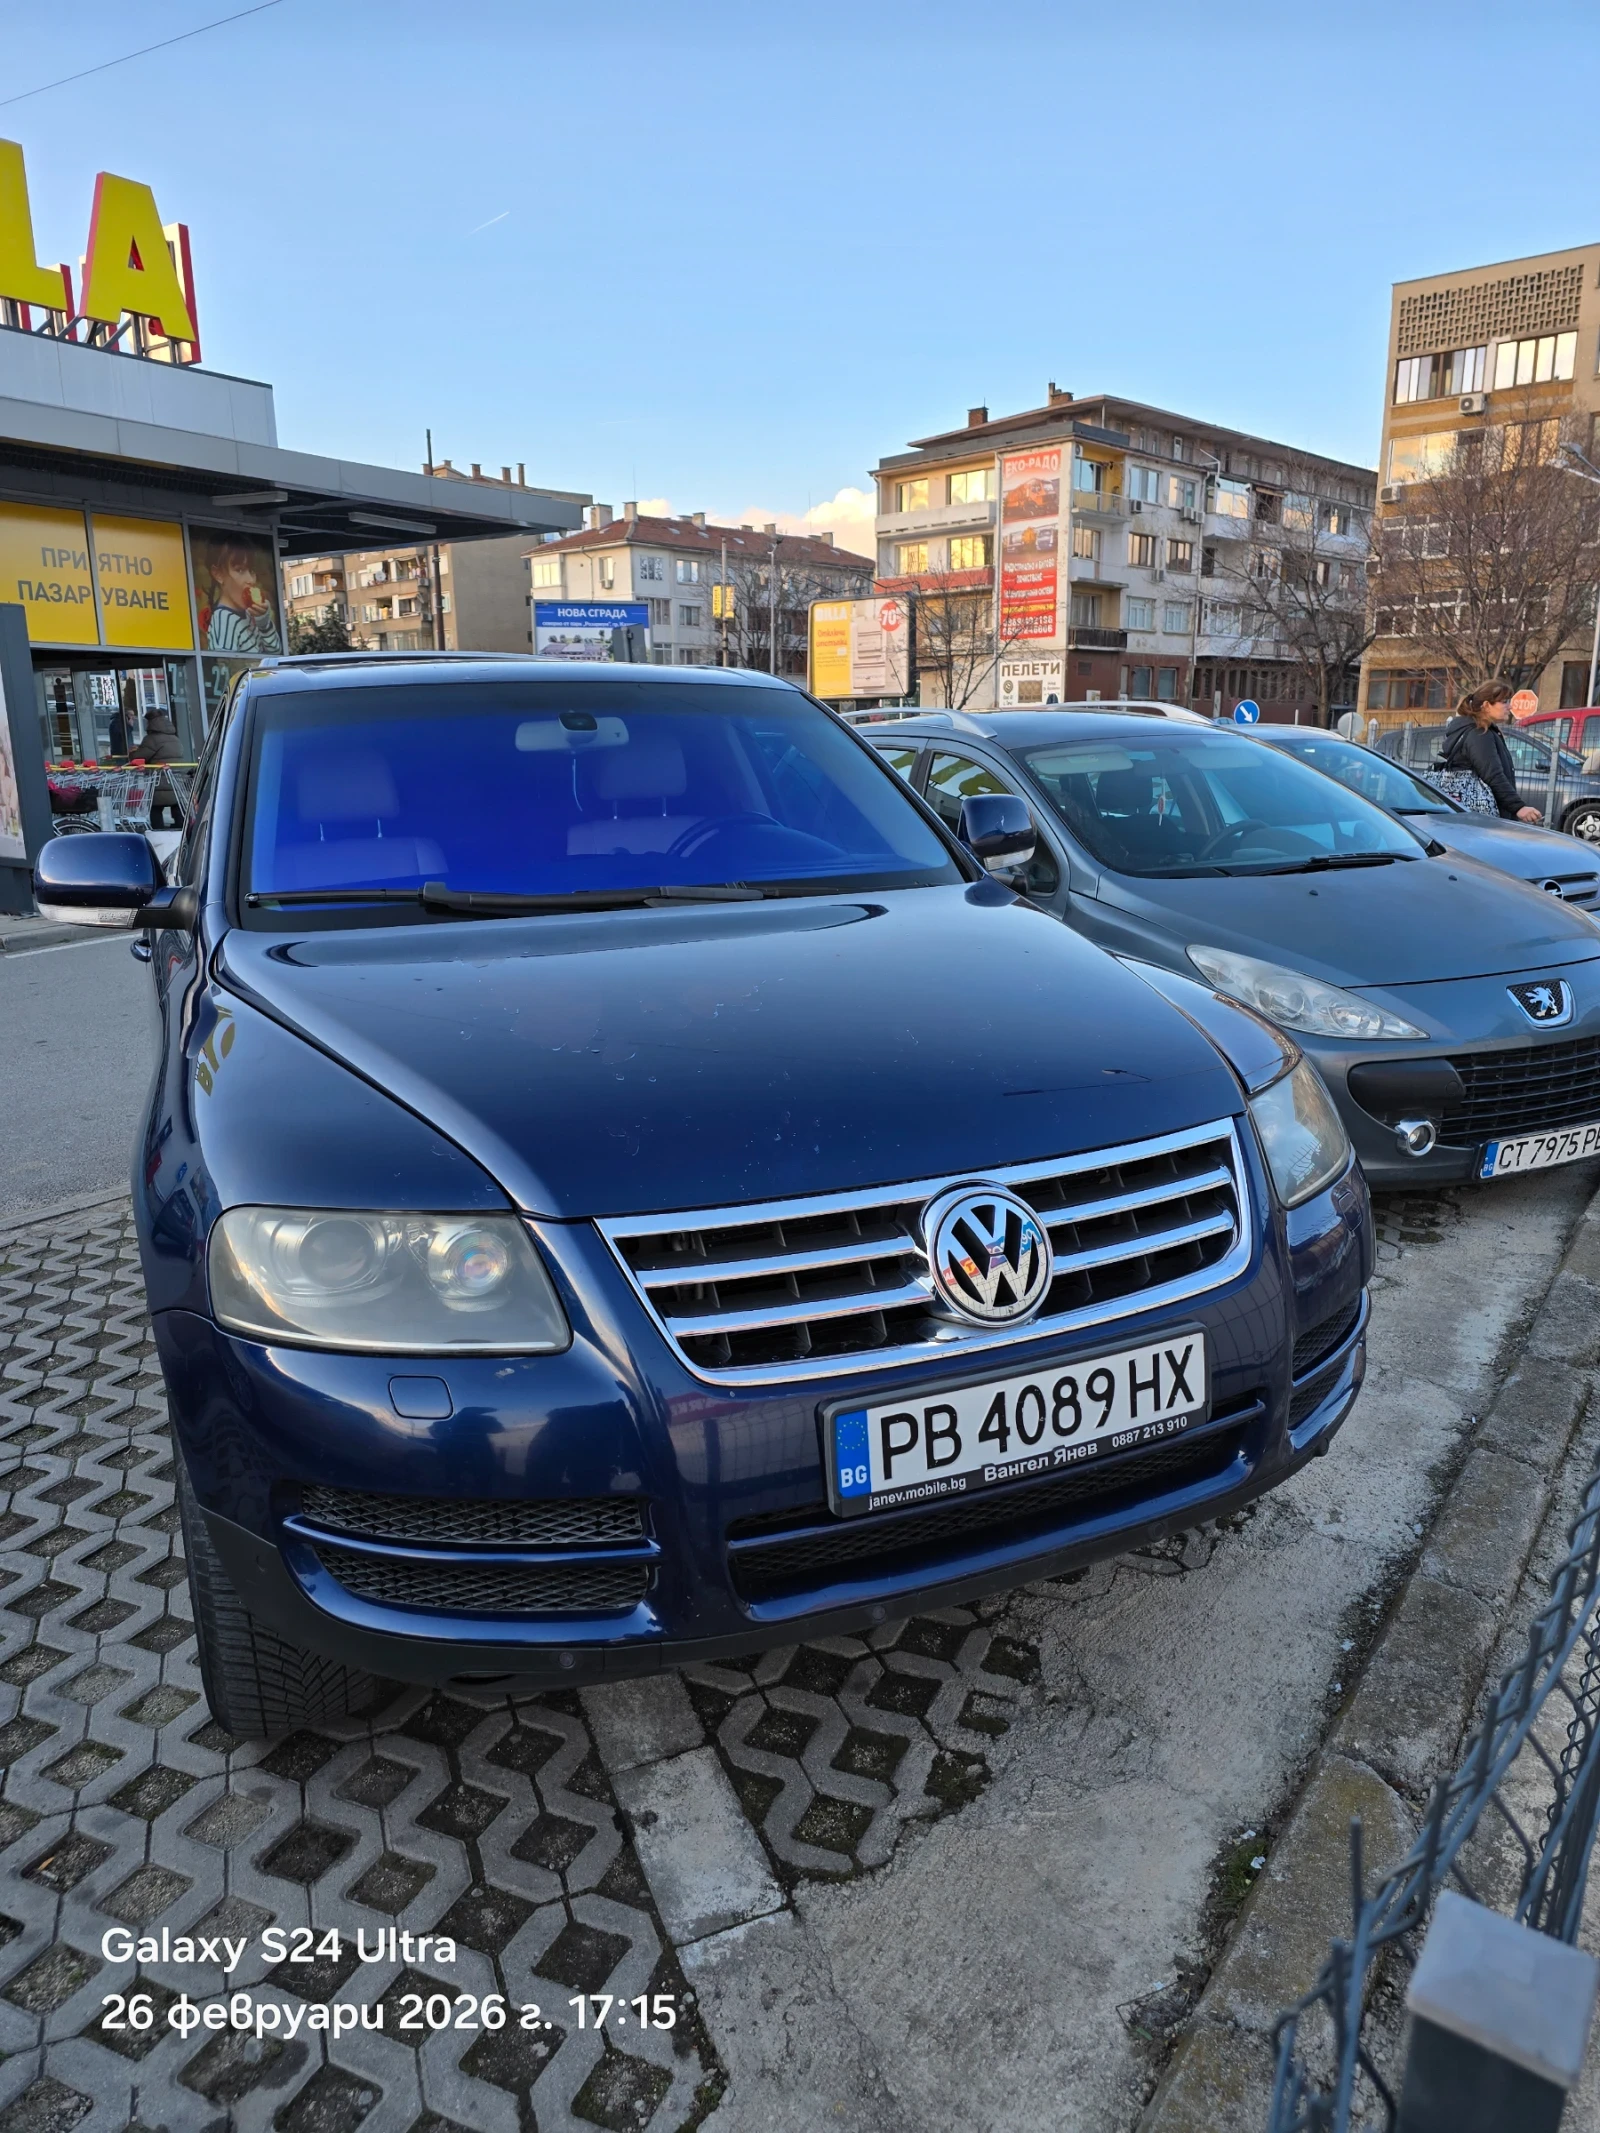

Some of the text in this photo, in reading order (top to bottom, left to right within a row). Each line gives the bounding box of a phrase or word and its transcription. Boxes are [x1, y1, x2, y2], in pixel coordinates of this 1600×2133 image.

[1005, 453, 1059, 479] ЕКО-РАДО
[17, 580, 170, 611] ПАЗАРУВАНЕ
[557, 608, 628, 619] НОВА СГРАДА
[1002, 662, 1061, 677] ПЕЛЕТИ
[1512, 699, 1535, 710] STOP
[1483, 1163, 1494, 1172] BG
[1499, 1141, 1530, 1169] CT
[1530, 1131, 1582, 1164] 7975
[840, 1344, 1195, 1489] BG PB 4089 HX
[984, 1416, 1188, 1482] Вангел Янев 0887 213 910
[868, 1477, 966, 1511] janev.mobile.bg
